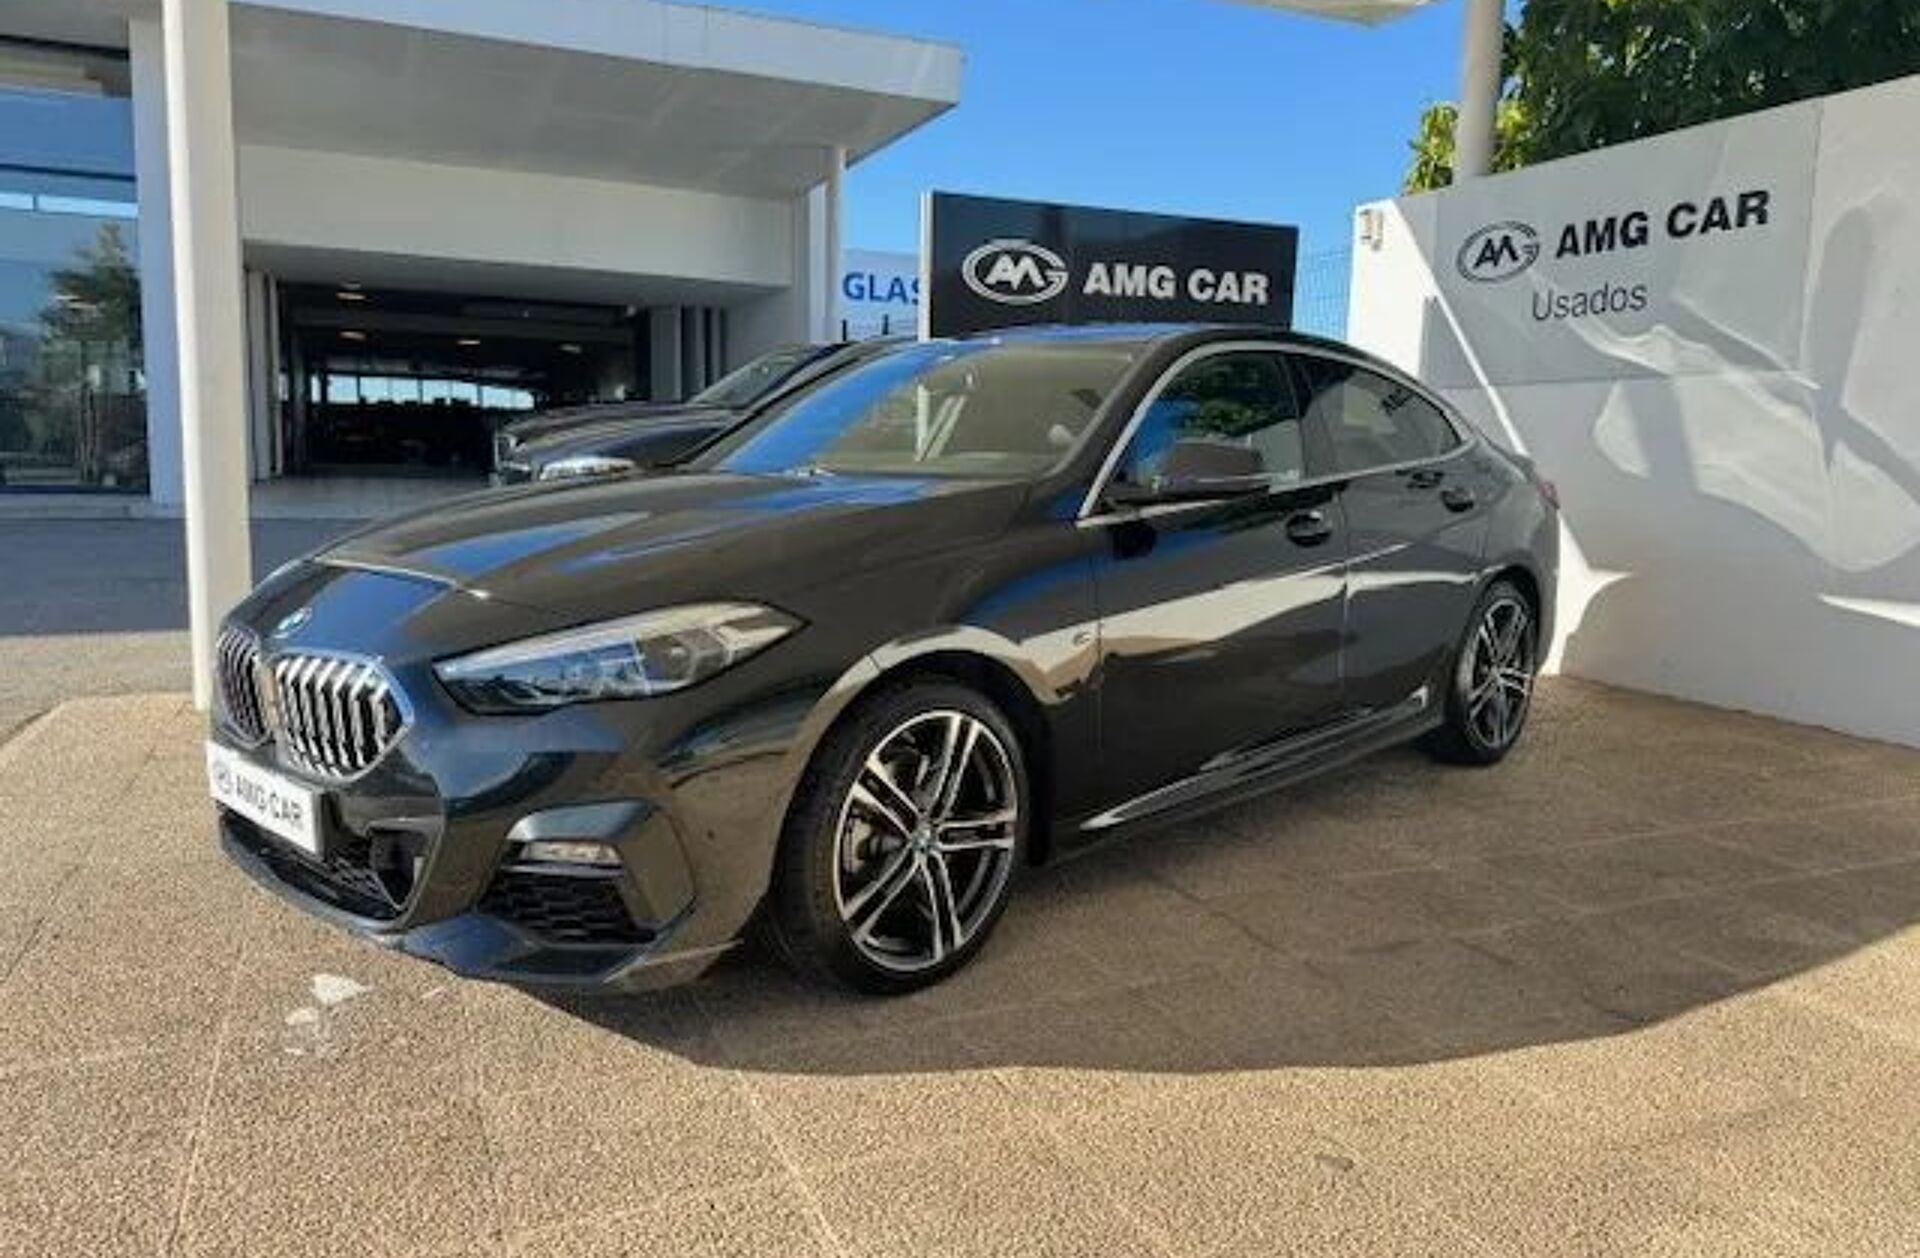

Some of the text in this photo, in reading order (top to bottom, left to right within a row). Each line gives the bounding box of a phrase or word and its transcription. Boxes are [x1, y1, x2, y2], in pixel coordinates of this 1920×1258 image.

[1556, 190, 1770, 258] AMG CAR
[1083, 263, 1269, 305] AMG CAR
[1532, 283, 1648, 321] Usados
